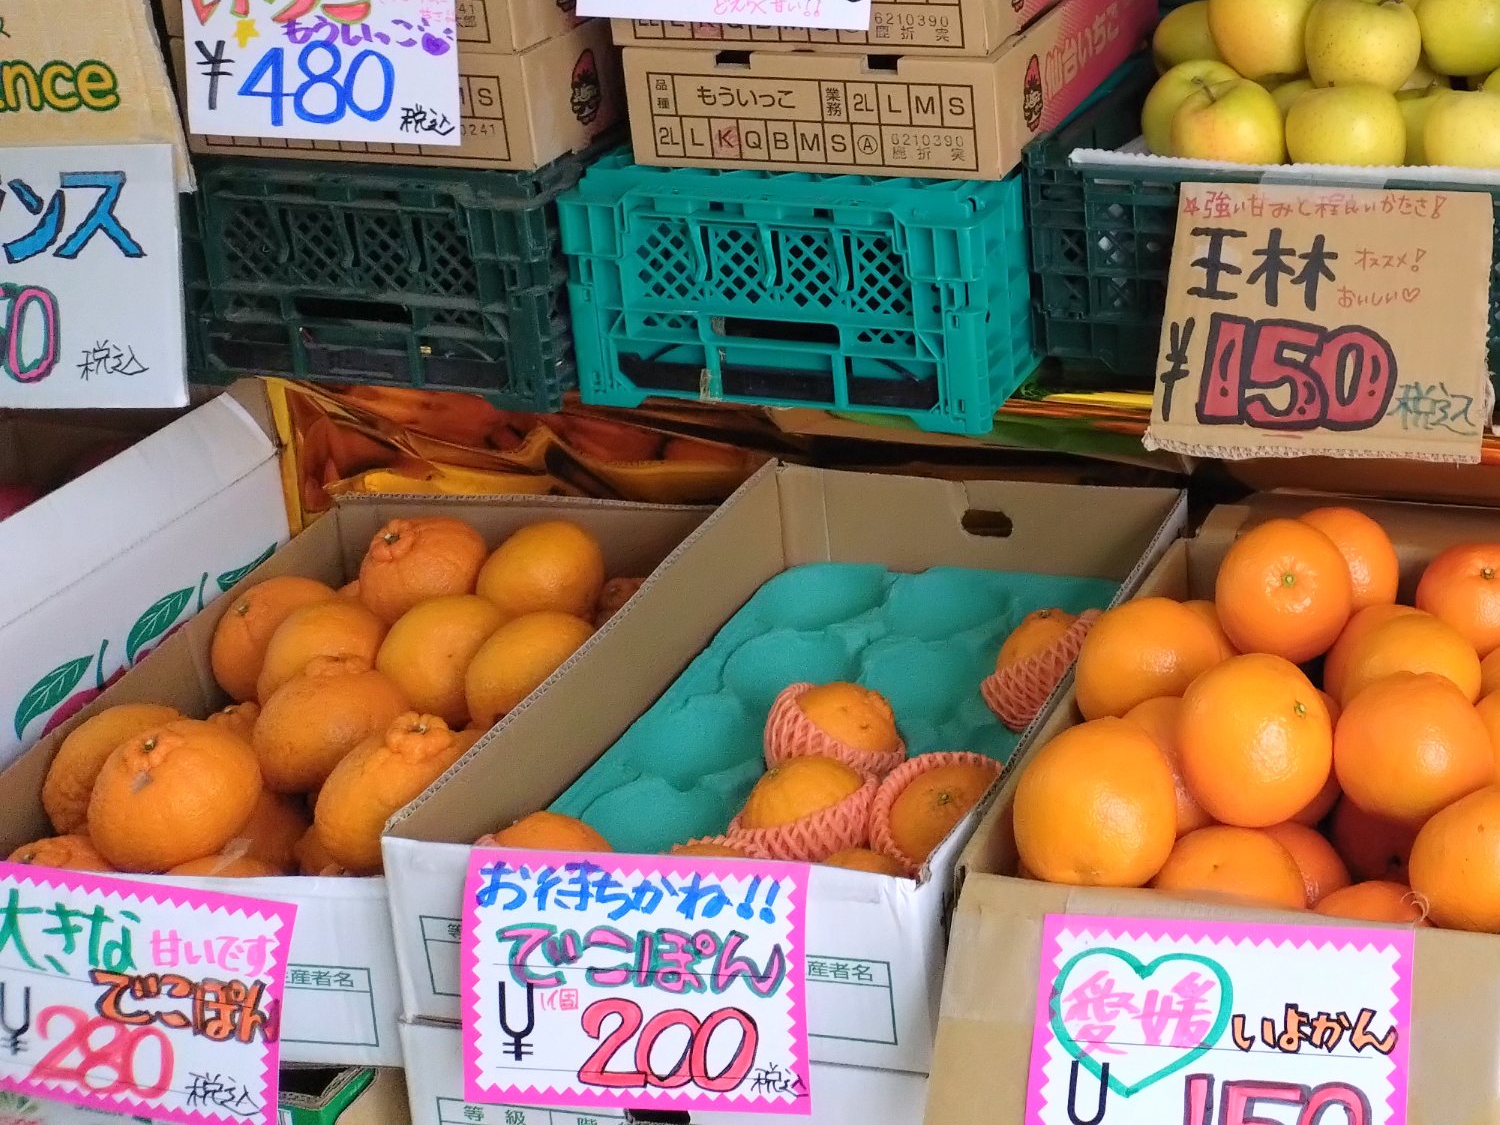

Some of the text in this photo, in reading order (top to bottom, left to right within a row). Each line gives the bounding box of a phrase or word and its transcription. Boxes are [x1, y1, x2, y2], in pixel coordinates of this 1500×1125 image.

[0, 59, 121, 112] nce
[477, 88, 493, 107] S
[655, 79, 670, 110] 品種
[697, 86, 796, 109] もういっこ
[825, 87, 842, 117] 業務
[853, 93, 874, 113] 2L
[888, 94, 901, 114] L
[915, 96, 935, 115] M
[949, 97, 966, 116] S
[400, 104, 456, 137] 税込
[659, 127, 680, 146] 2L
[691, 128, 704, 147] L
[718, 129, 734, 148] K
[745, 130, 762, 150] Q
[773, 131, 789, 150] B
[801, 132, 821, 152] M
[831, 134, 847, 153] S
[0, 171, 148, 264] ンス
[1187, 227, 1339, 311] 王林
[77, 340, 150, 381] 税込
[1387, 381, 1478, 436] 税込
[475, 859, 781, 925] お待ちかね!!
[0, 888, 277, 976] 大きな 甘いです
[496, 923, 787, 997] でこぽん
[1064, 969, 1219, 1056] 愛媛
[577, 998, 759, 1092] 200
[1232, 1003, 1399, 1056] いよかん
[185, 1071, 263, 1117] 税込
[751, 1062, 809, 1099] 税込
